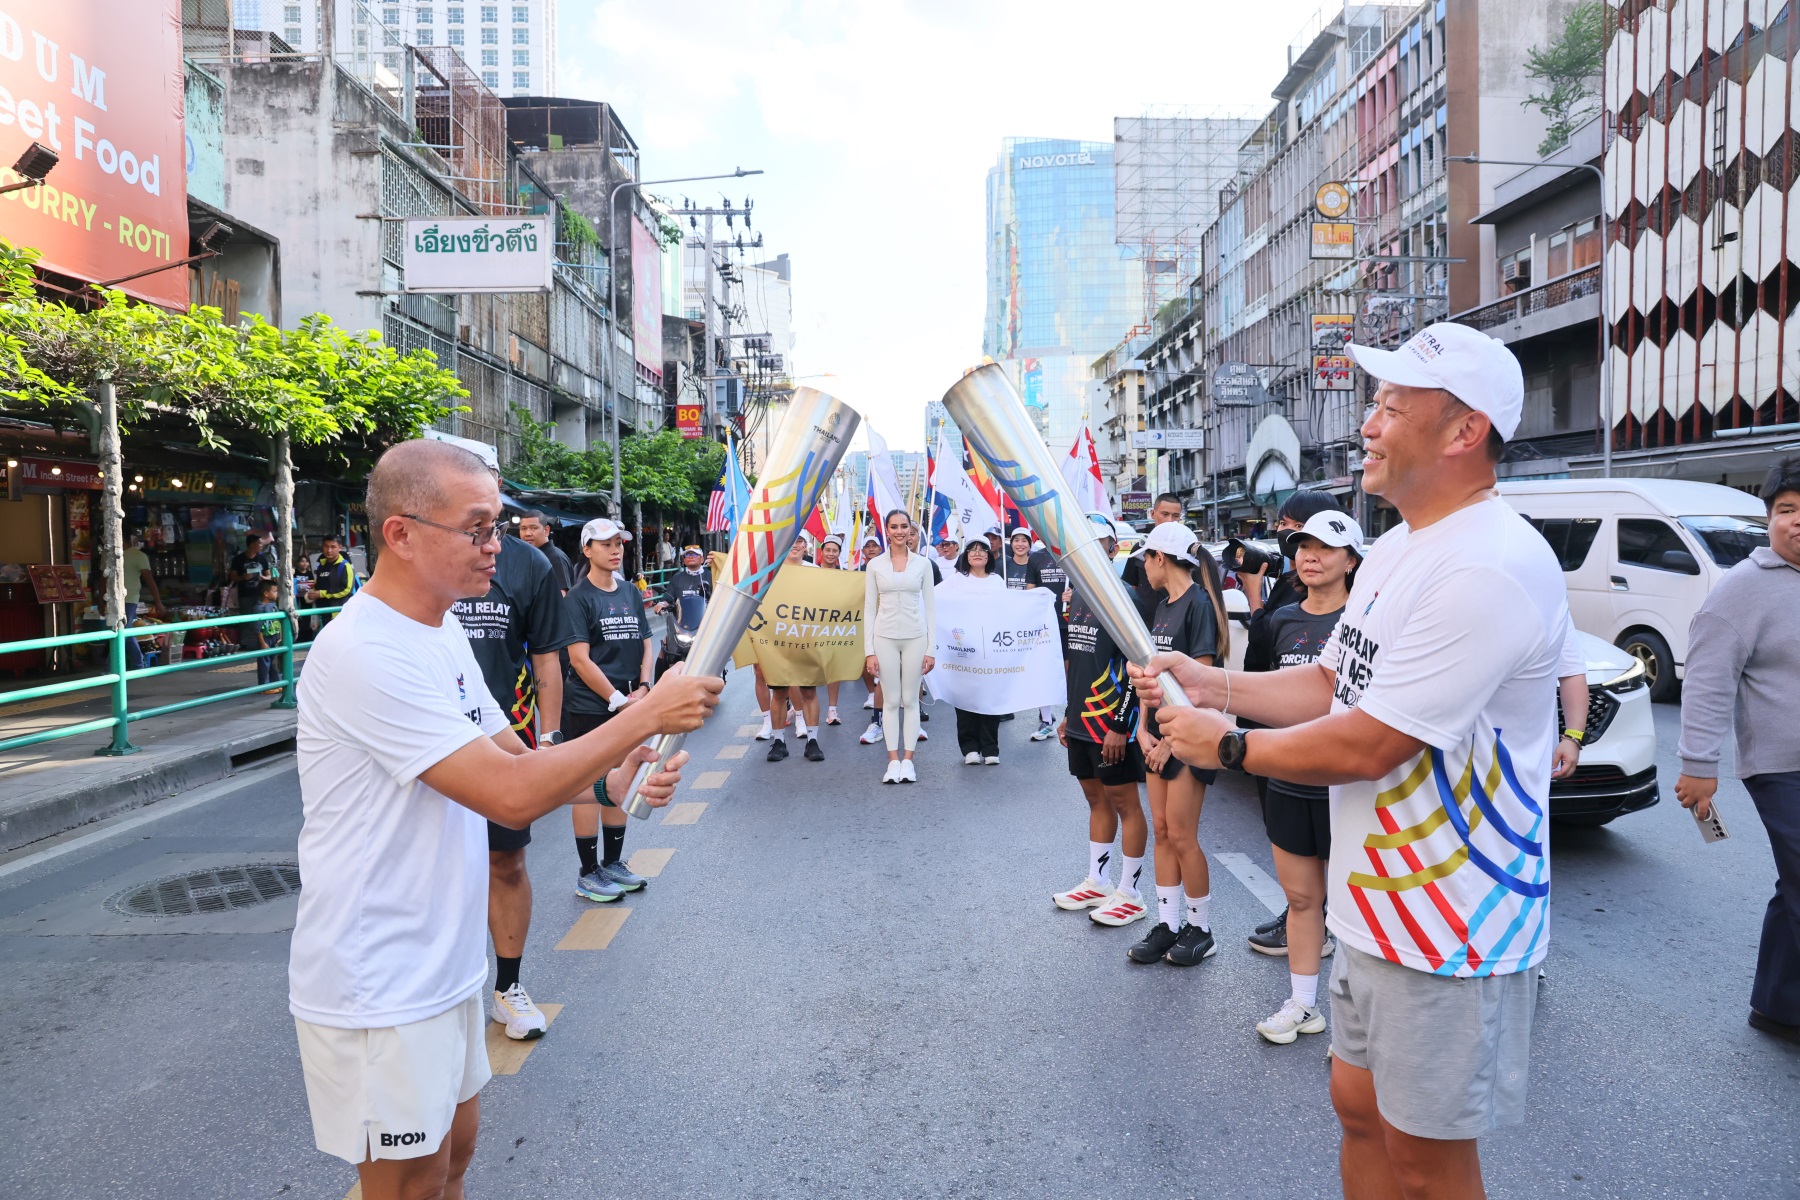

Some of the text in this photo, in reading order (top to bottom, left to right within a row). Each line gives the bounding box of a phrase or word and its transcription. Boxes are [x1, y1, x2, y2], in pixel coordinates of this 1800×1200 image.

[74, 115, 160, 196] Food
[1020, 152, 1095, 169] NOVOTEL
[119, 215, 170, 261] ROTI
[415, 223, 537, 253] เอี่ยงซิ่วตึ๊ง
[813, 425, 841, 444] THAILAND
[65, 473, 89, 483] Street
[1122, 501, 1151, 511] Massage
[475, 601, 511, 616] RELAY
[775, 604, 862, 623] CENTRAL
[599, 616, 624, 626] TORCH
[603, 633, 630, 641] THAILAND
[775, 621, 857, 638] PATTANA
[773, 640, 811, 650] BETTER
[814, 640, 854, 648] FUTURES
[992, 631, 1015, 647] 45
[947, 644, 976, 654] THAILAND
[1279, 654, 1310, 664] TORCH
[942, 663, 1025, 675] OFFICIAL GOLD SPONSOR
[1118, 691, 1132, 716] UNDER
